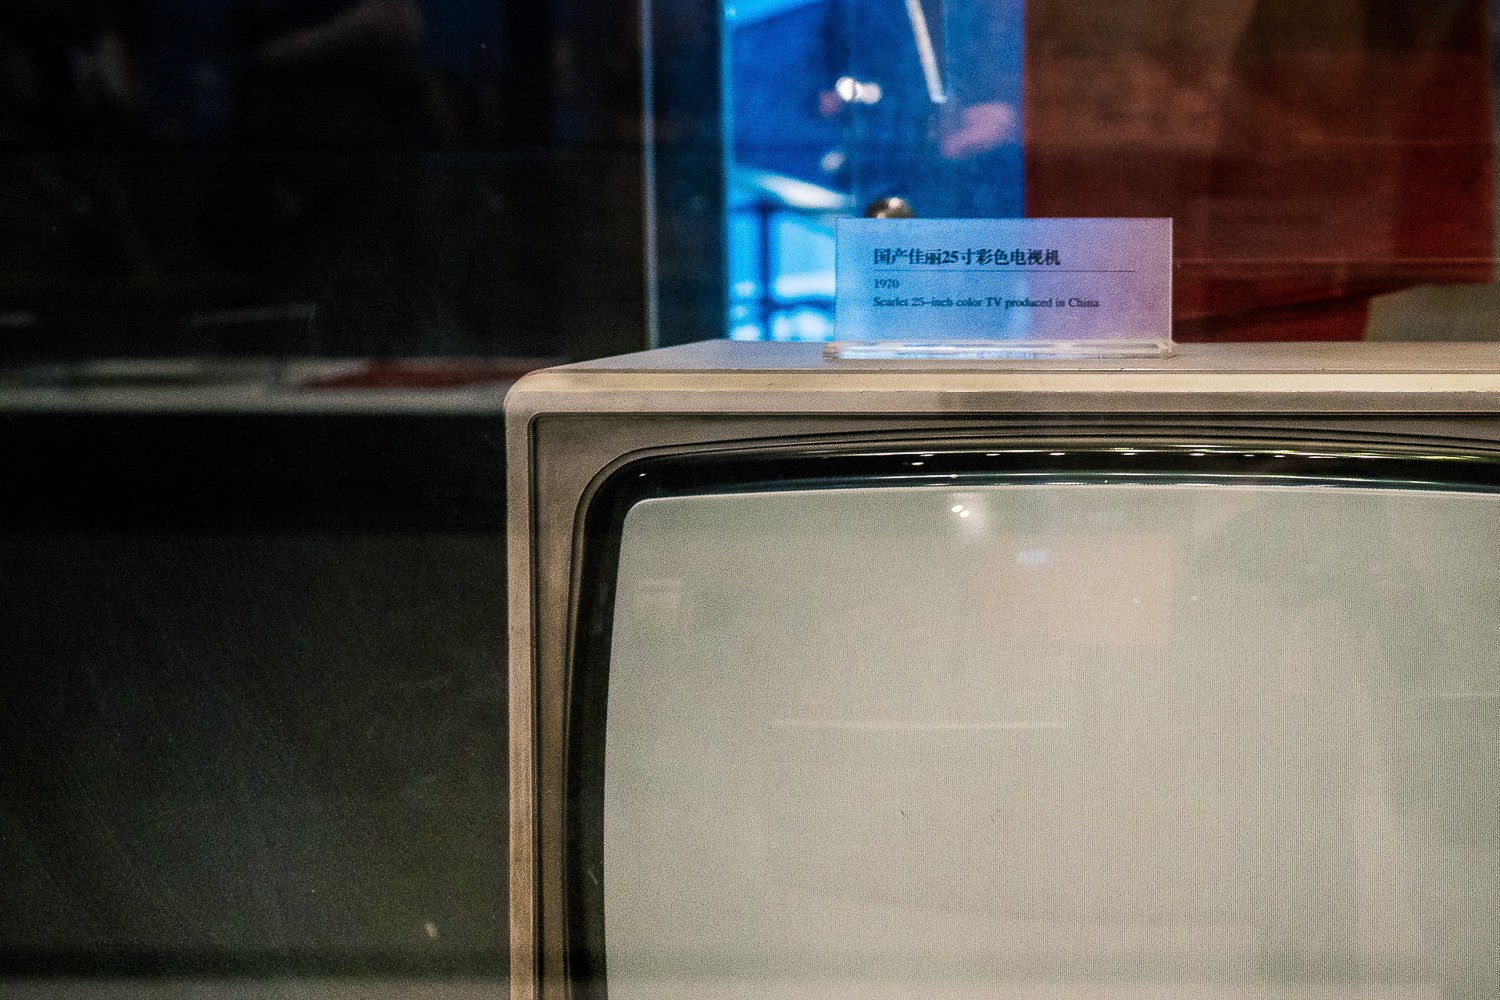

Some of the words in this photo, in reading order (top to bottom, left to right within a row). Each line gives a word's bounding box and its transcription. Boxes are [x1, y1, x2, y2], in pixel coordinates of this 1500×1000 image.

[873, 248, 1061, 266] 国产佳丽25寸彩色电视机
[873, 278, 900, 289] 1970
[872, 296, 908, 308] Scarlet
[955, 297, 982, 308] color
[985, 297, 1002, 307] TV
[1005, 297, 1053, 310] produced
[1055, 298, 1066, 307] in
[1067, 297, 1100, 308] China
